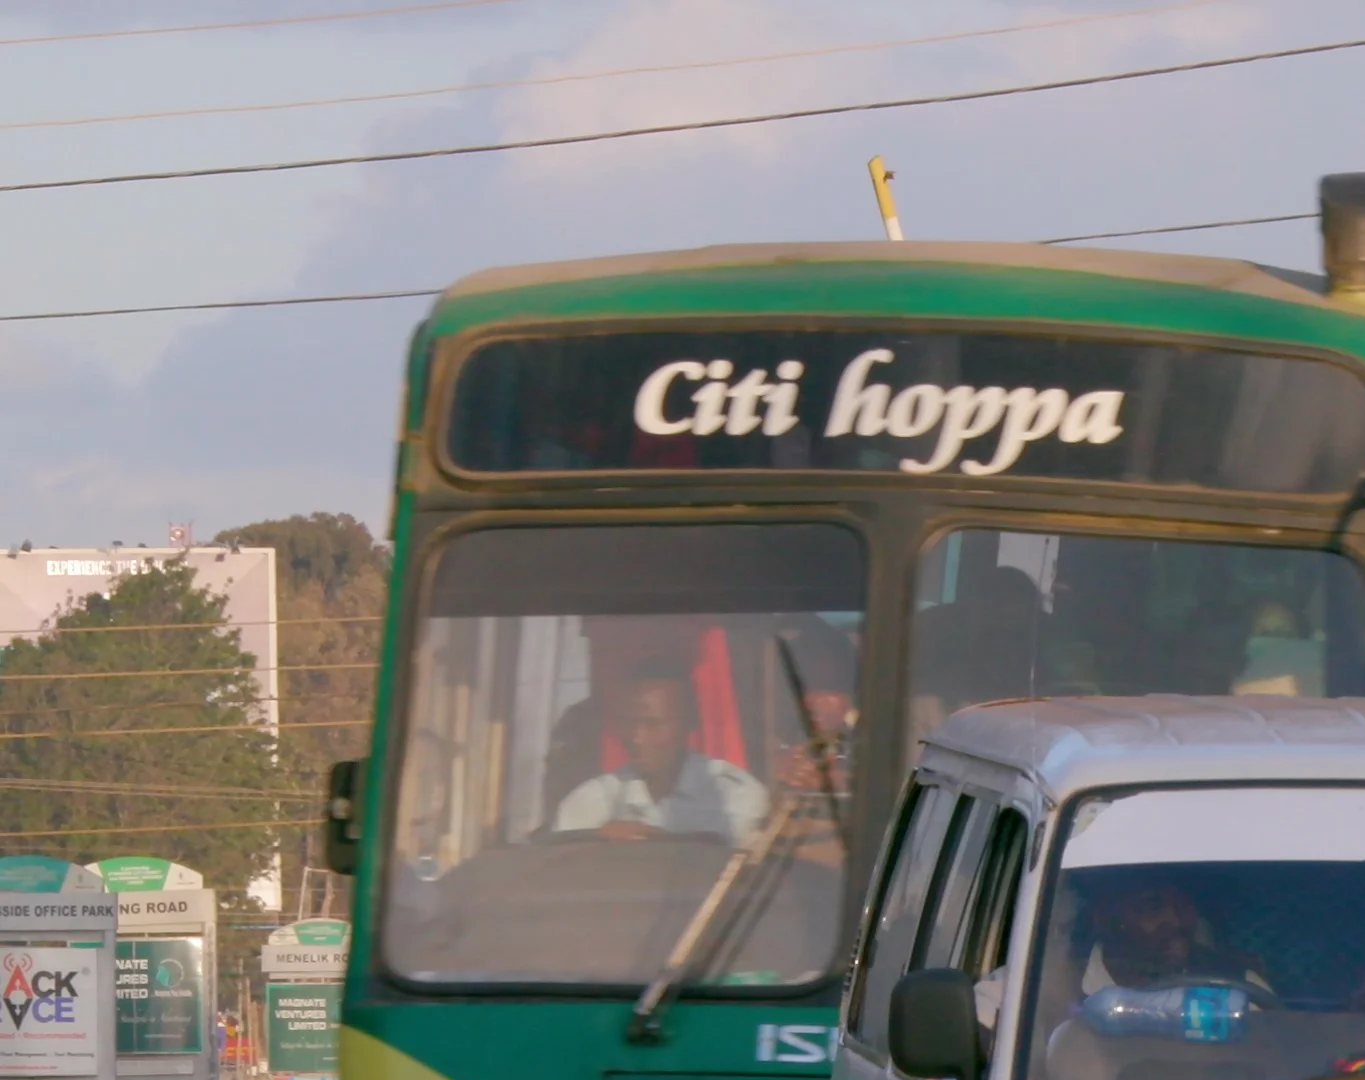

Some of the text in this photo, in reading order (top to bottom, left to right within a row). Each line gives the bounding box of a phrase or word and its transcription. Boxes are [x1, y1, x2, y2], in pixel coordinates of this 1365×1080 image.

[634, 348, 1125, 476] Citi hoppa
[34, 905, 77, 917] OFFICE
[81, 905, 114, 917] PARK
[147, 901, 188, 913] ROAD
[276, 953, 328, 963] MENELIK
